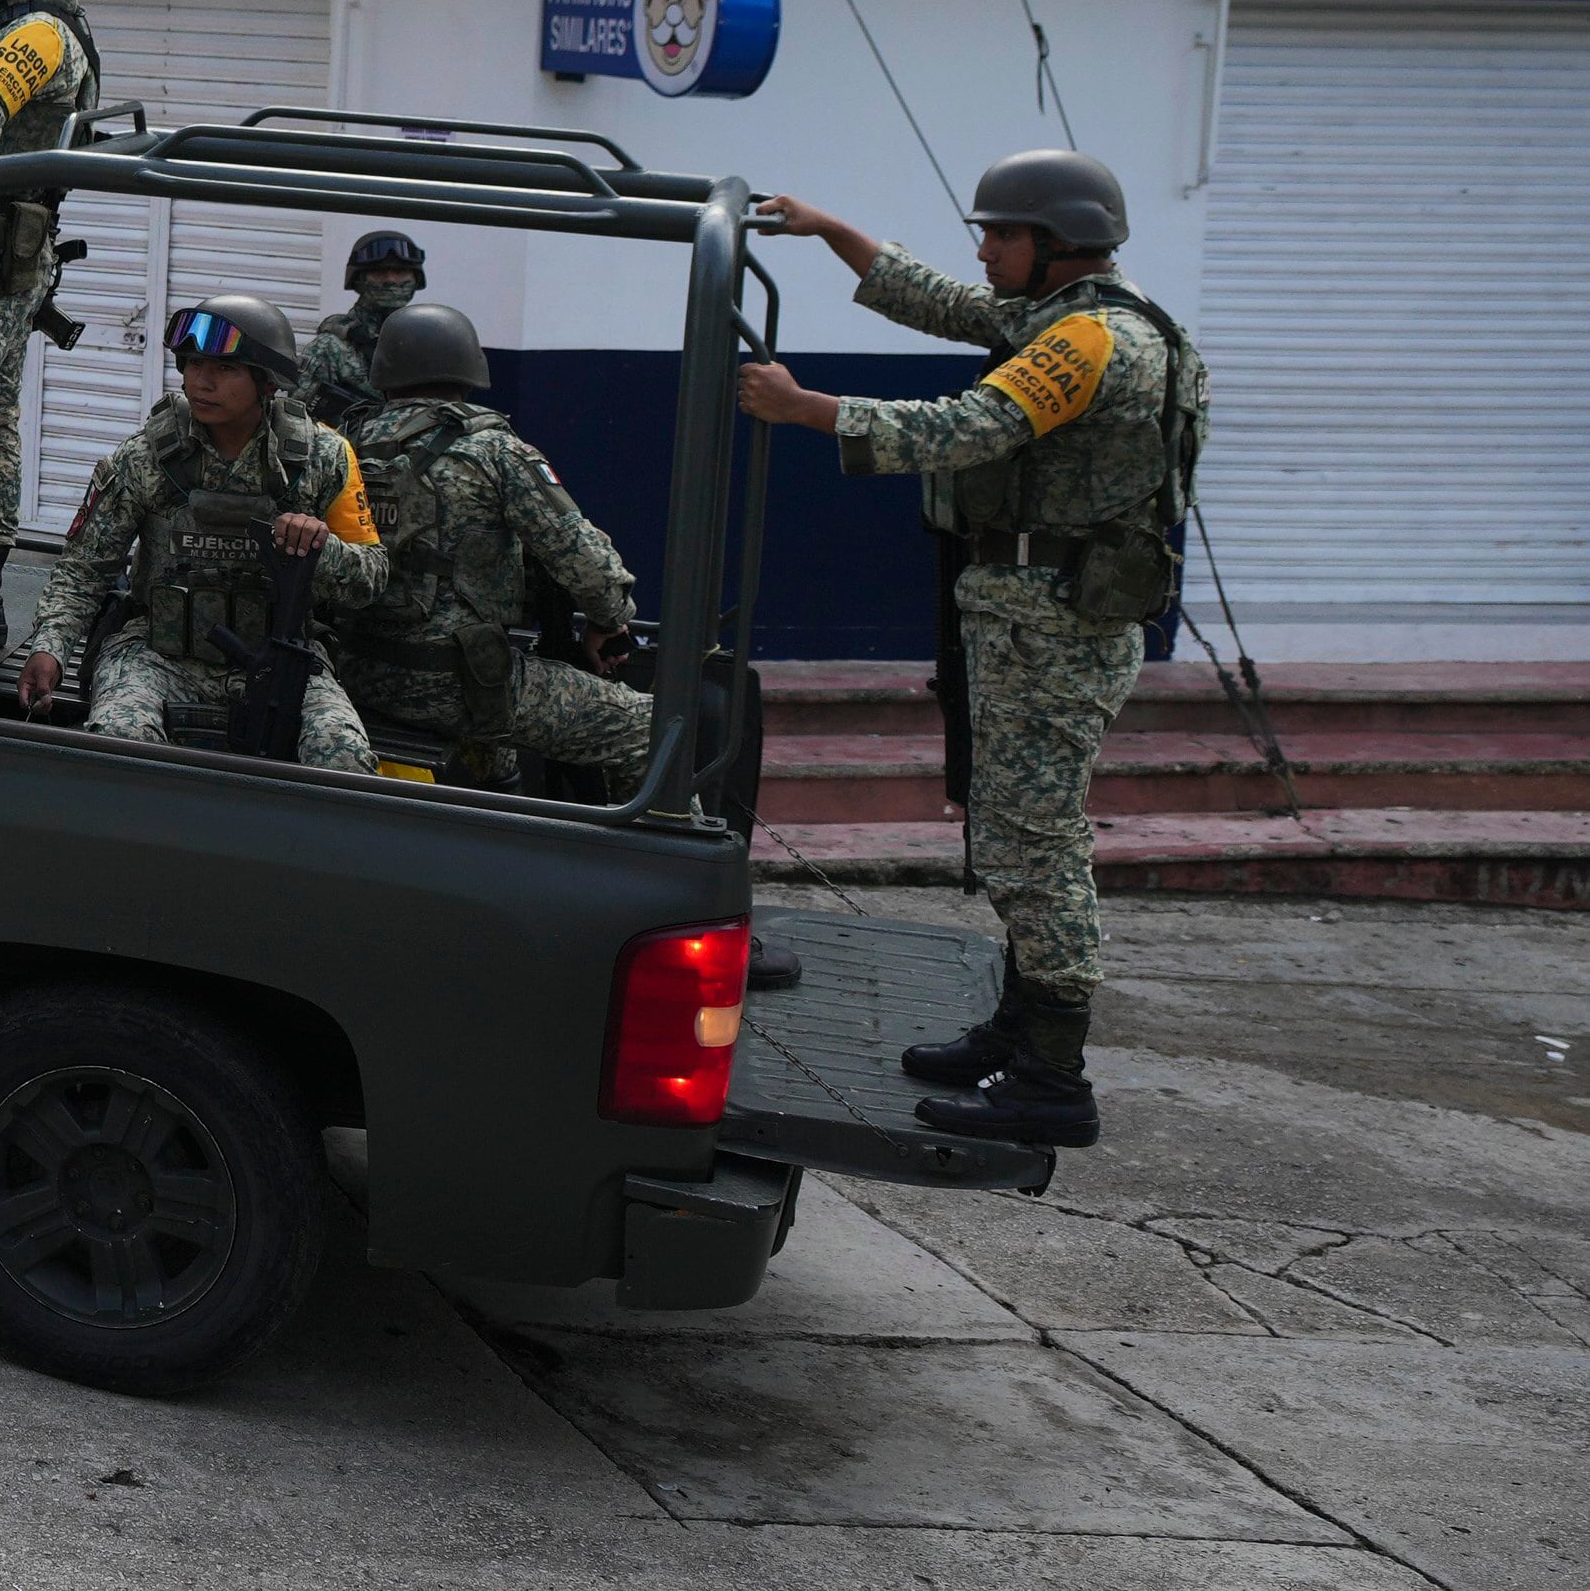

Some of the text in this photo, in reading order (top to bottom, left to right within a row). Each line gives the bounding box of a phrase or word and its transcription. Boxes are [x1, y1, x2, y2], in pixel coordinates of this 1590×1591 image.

[549, 15, 627, 57] SIMILARES
[10, 37, 48, 81] LABOR
[1017, 347, 1086, 406] OCIAL
[182, 534, 260, 551] EJÉRCIT
[190, 549, 258, 560] MEXICAN
